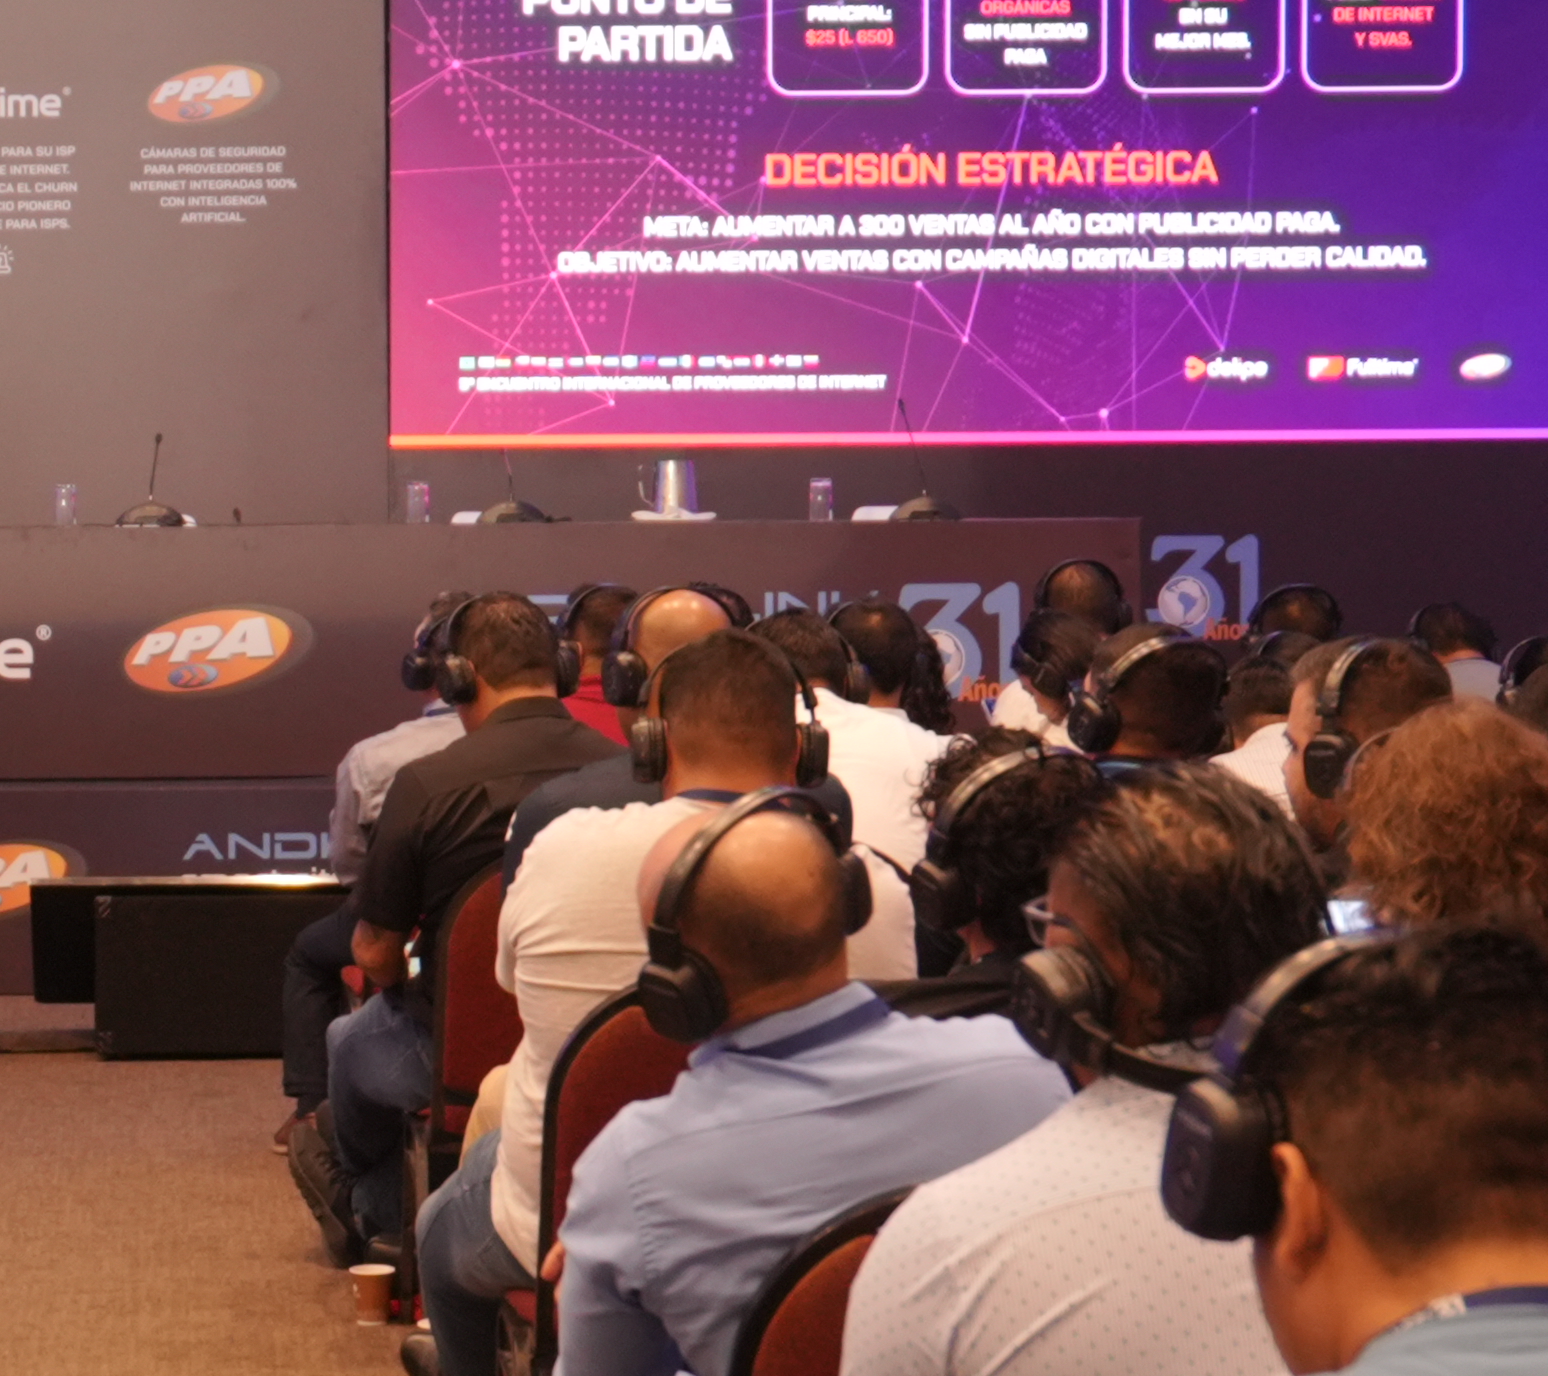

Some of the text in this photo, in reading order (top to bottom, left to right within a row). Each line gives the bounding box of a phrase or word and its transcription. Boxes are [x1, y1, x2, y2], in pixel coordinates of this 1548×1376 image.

[1333, 6, 1434, 23] DE INTERNET
[558, 25, 733, 63] PARTIDA
[806, 28, 835, 46] $25
[856, 28, 894, 46] 650)
[1355, 32, 1366, 47] Y
[153, 69, 252, 104] PPA
[1, 146, 33, 157] PARA
[36, 146, 52, 157] SU
[56, 146, 75, 156] ISP
[141, 146, 286, 159] CÁMARAS DE SEGURIDAD
[10, 164, 70, 175] INTERNET.
[144, 162, 283, 174] PARA PROVEEDORES DE
[764, 141, 1219, 189] DECISIÓN ESTRATÉGICA
[17, 183, 31, 193] EL
[35, 182, 77, 193] CHURN
[130, 178, 297, 191] INTERNET INTEGRADAS 100%
[18, 200, 70, 211] PIONERO
[160, 195, 267, 207] CON INTELIGENCIA
[6, 218, 37, 229] PARA
[40, 218, 70, 229] ISPS.
[181, 212, 246, 223] ARTIFICIAL.
[643, 216, 709, 238] META:
[712, 215, 831, 237] AUMENTAR
[838, 215, 855, 236] A
[908, 214, 995, 235] VENTAS
[999, 214, 1029, 235] AL
[1033, 208, 1080, 234] AÑO
[1085, 213, 1134, 234] CON
[1139, 212, 1271, 234] PUBLICIDAD
[1276, 211, 1340, 232] PAGA.
[557, 244, 1426, 273] OBJETIVO: AUMENTAR VENTAS CON CAMPAÑAS DIGITALES SIN PERDER CALIDAD.
[1145, 534, 1259, 638] 31
[131, 616, 275, 666] PPA
[898, 581, 1020, 698] 31
[958, 676, 1010, 702] Año
[183, 832, 330, 860] ANDI
